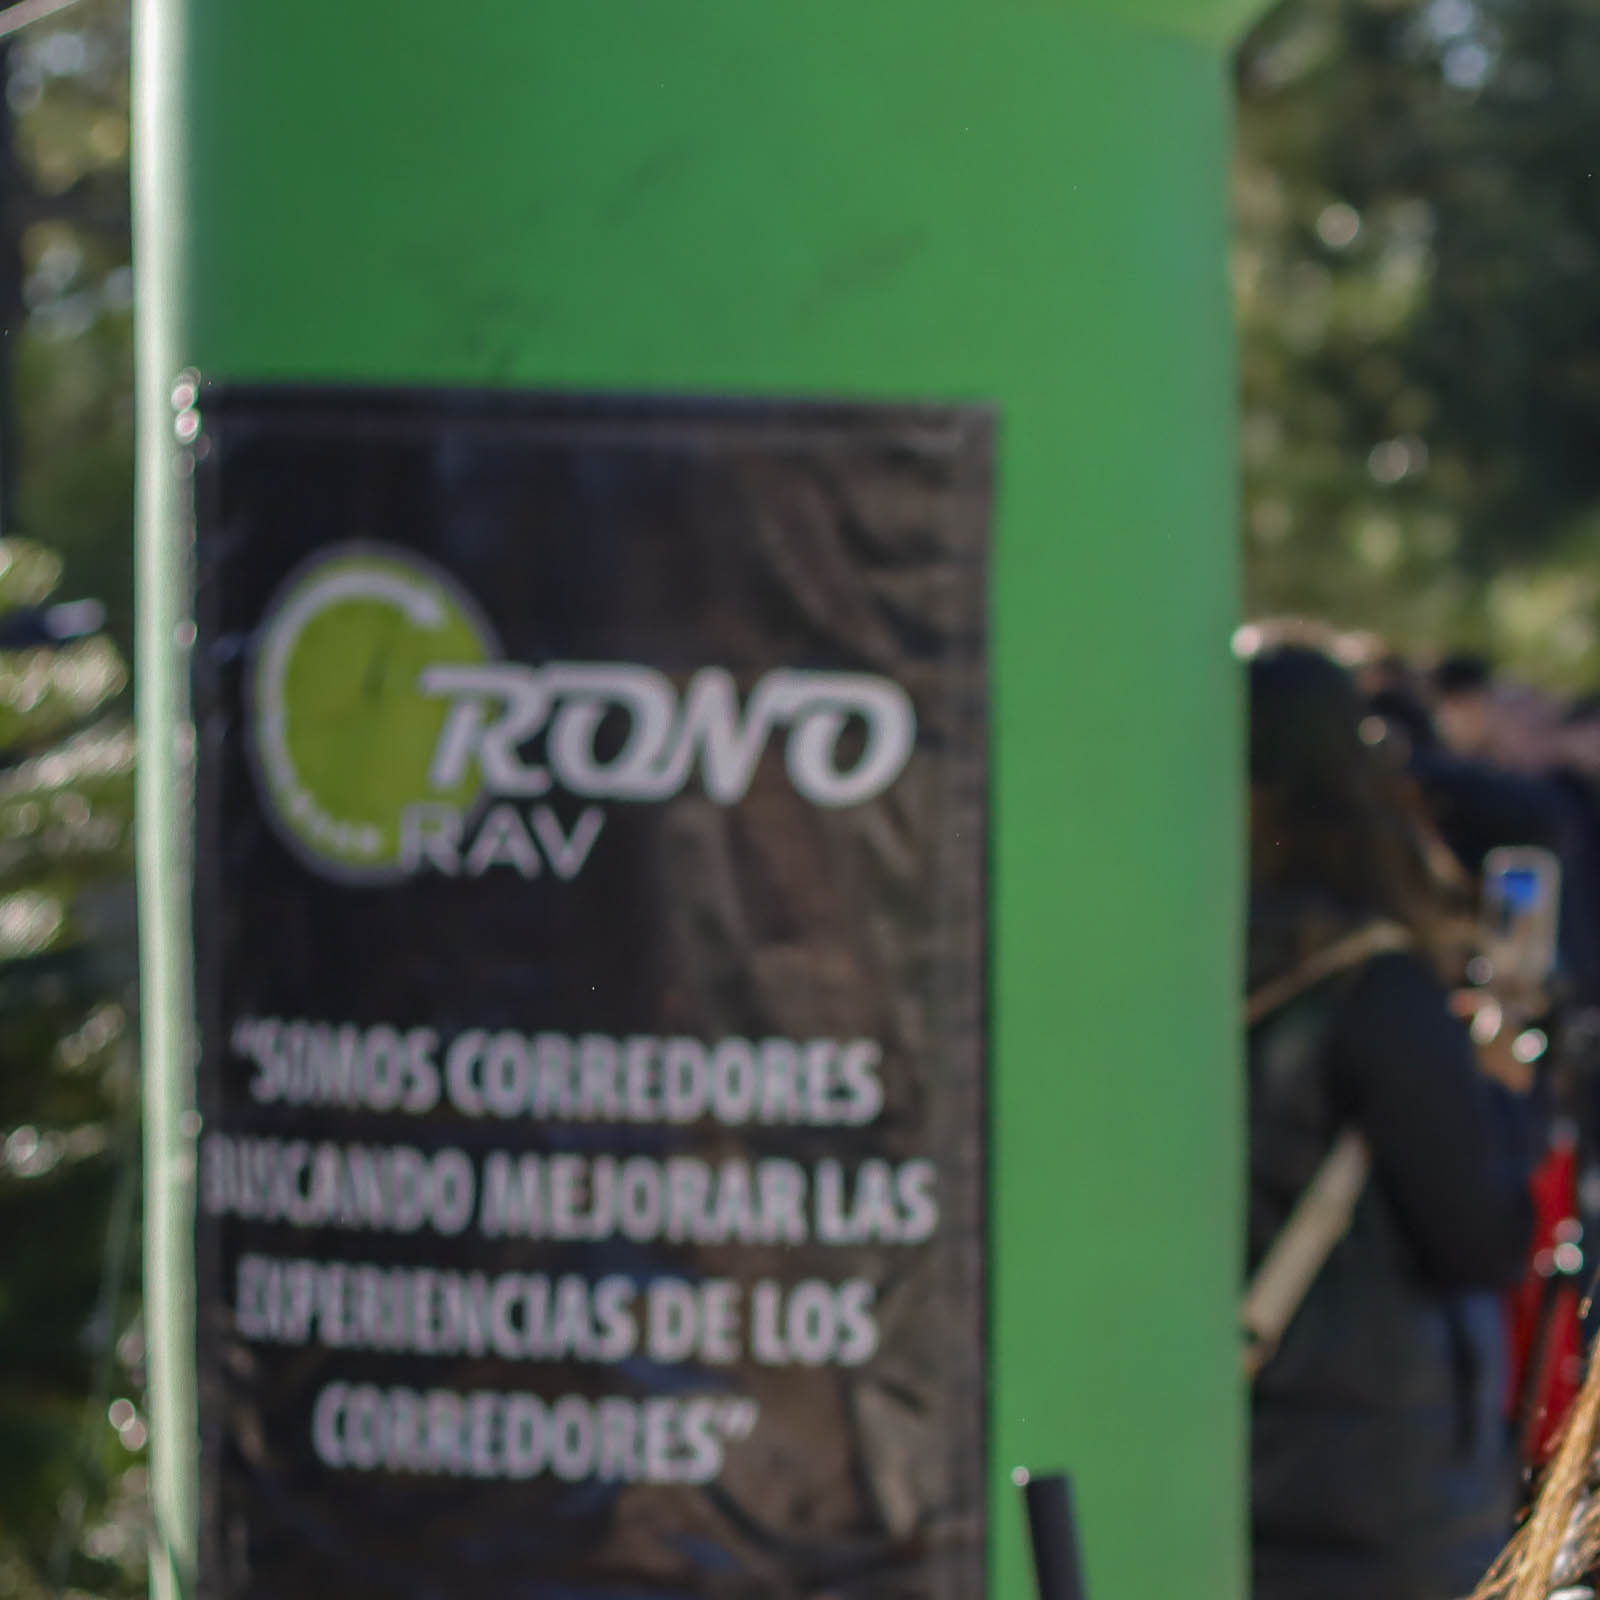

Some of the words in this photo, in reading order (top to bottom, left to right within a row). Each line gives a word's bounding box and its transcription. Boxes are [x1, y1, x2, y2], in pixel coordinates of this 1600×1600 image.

[398, 808, 604, 878] RAV
[446, 1028, 886, 1126] CORREDORES
[480, 1150, 810, 1244] MEJORAR
[814, 1158, 940, 1244] LAS
[648, 1276, 741, 1360] DE
[752, 1278, 880, 1368] LOS
